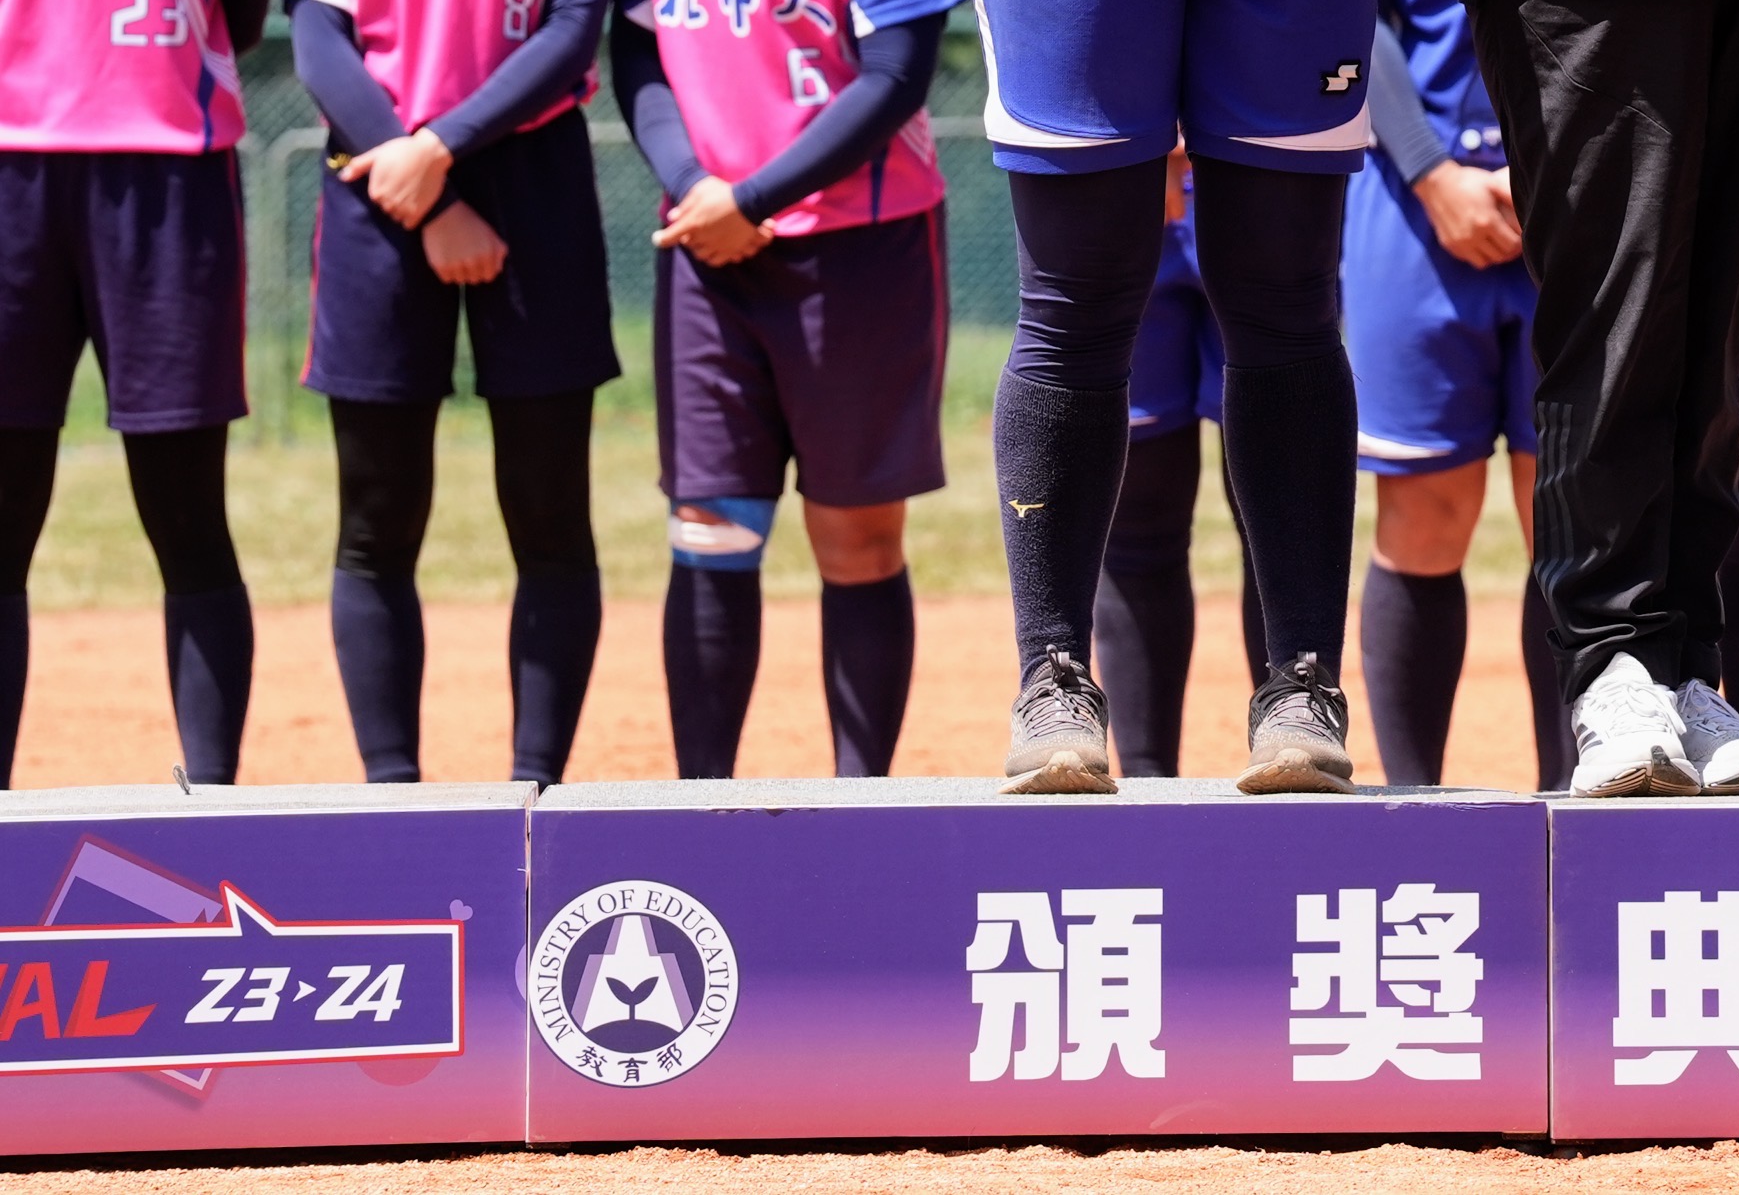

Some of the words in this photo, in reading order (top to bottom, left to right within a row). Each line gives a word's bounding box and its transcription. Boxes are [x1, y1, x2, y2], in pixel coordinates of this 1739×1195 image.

[786, 47, 830, 107] 6
[0, 960, 158, 1041] AL
[537, 903, 593, 1043] MINISTRY
[596, 888, 635, 914] OF
[645, 889, 730, 1038] EDUCATION
[575, 1042, 683, 1083] 教育部
